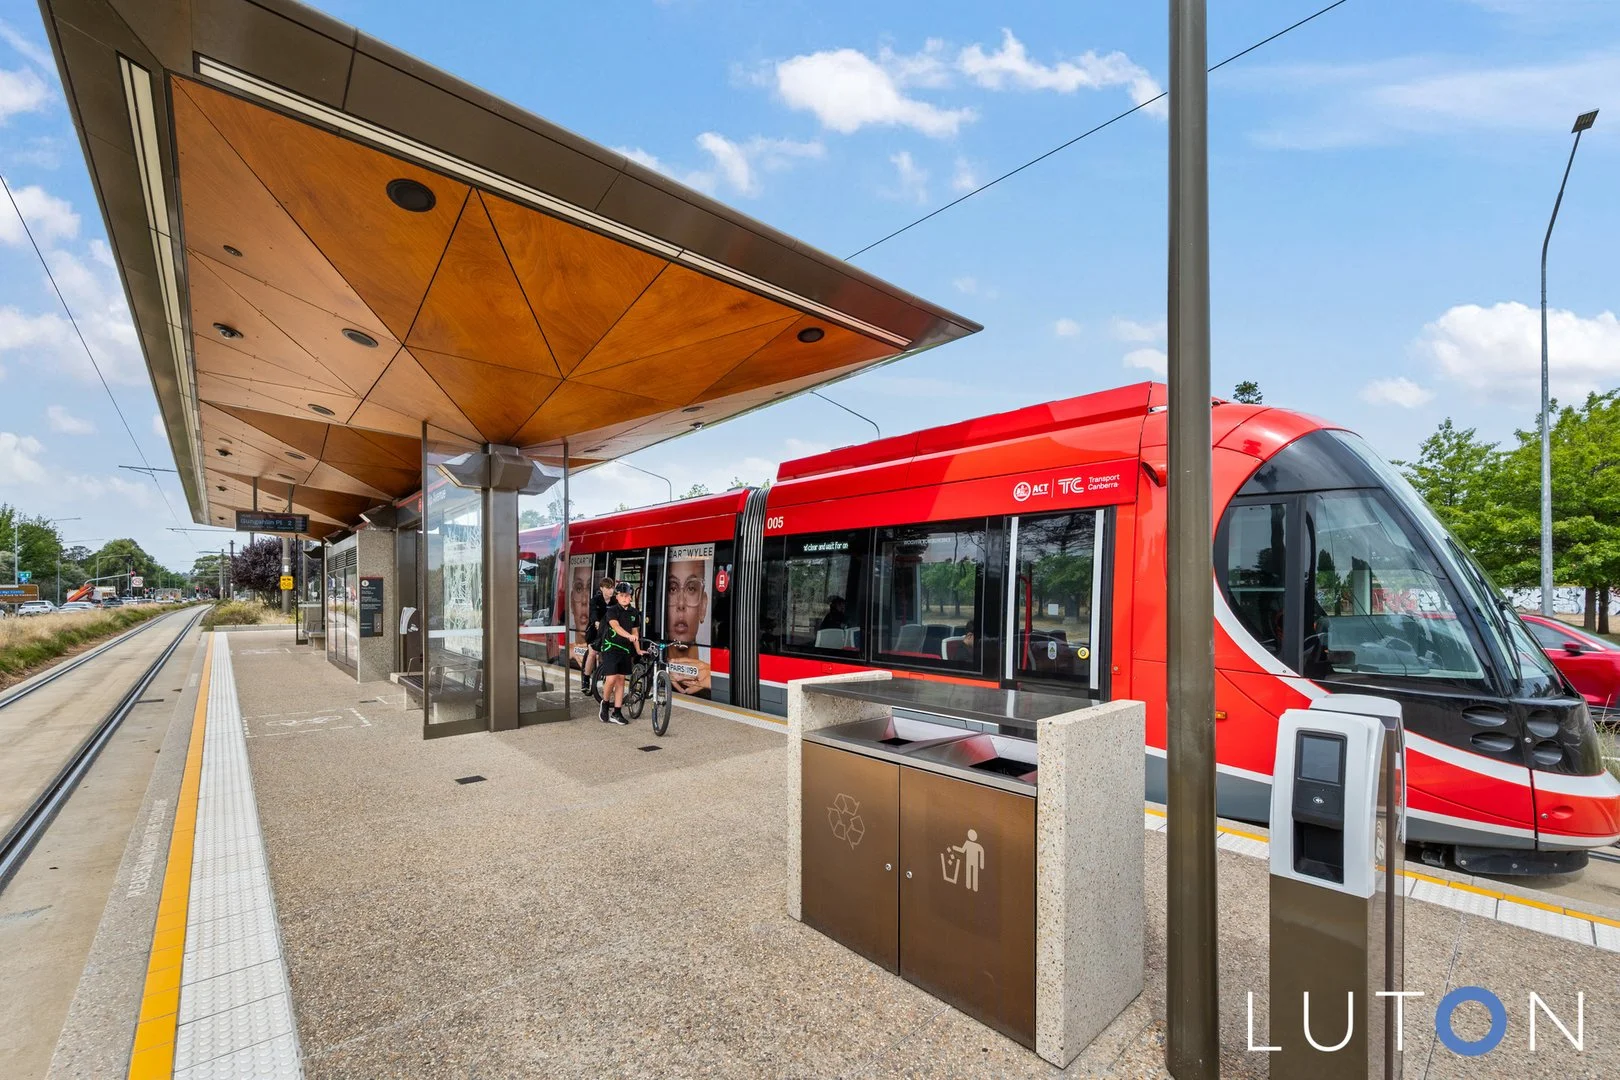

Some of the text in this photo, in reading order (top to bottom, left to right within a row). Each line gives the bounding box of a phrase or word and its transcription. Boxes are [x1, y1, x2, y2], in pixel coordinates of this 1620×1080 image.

[1089, 474, 1120, 484] Transport
[1033, 483, 1049, 493] ACT
[1088, 482, 1119, 491] Canberra
[240, 518, 275, 526] Gungahlin
[767, 516, 784, 530] 005
[687, 546, 713, 557] WYLEE
[571, 554, 586, 565] OSCAR
